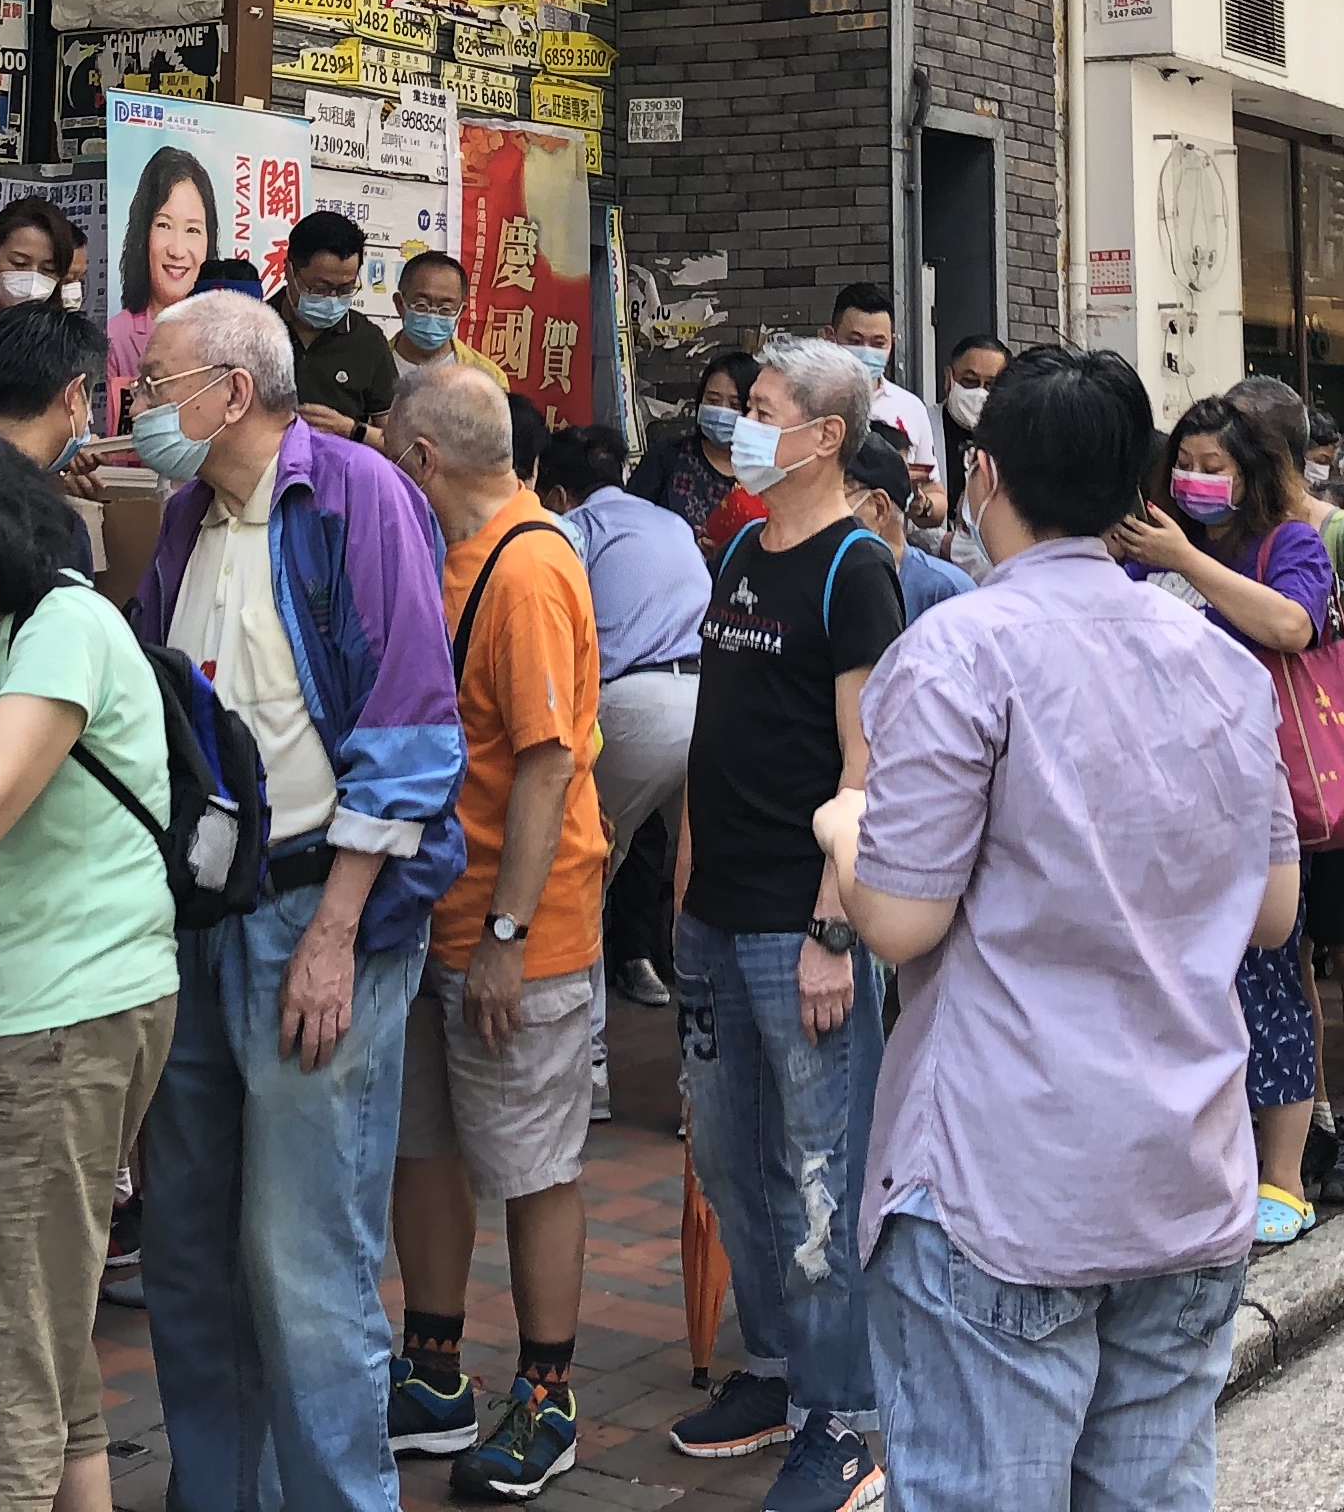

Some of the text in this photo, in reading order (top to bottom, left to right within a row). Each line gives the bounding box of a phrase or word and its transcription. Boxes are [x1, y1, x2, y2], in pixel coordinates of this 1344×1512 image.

[1108, 7, 1152, 19] 9147 6000
[545, 48, 606, 67] 6859 3500
[481, 85, 513, 111] 6469
[629, 98, 682, 112] 26 390 390
[318, 103, 356, 128] 知租處
[234, 155, 251, 241] KWAN
